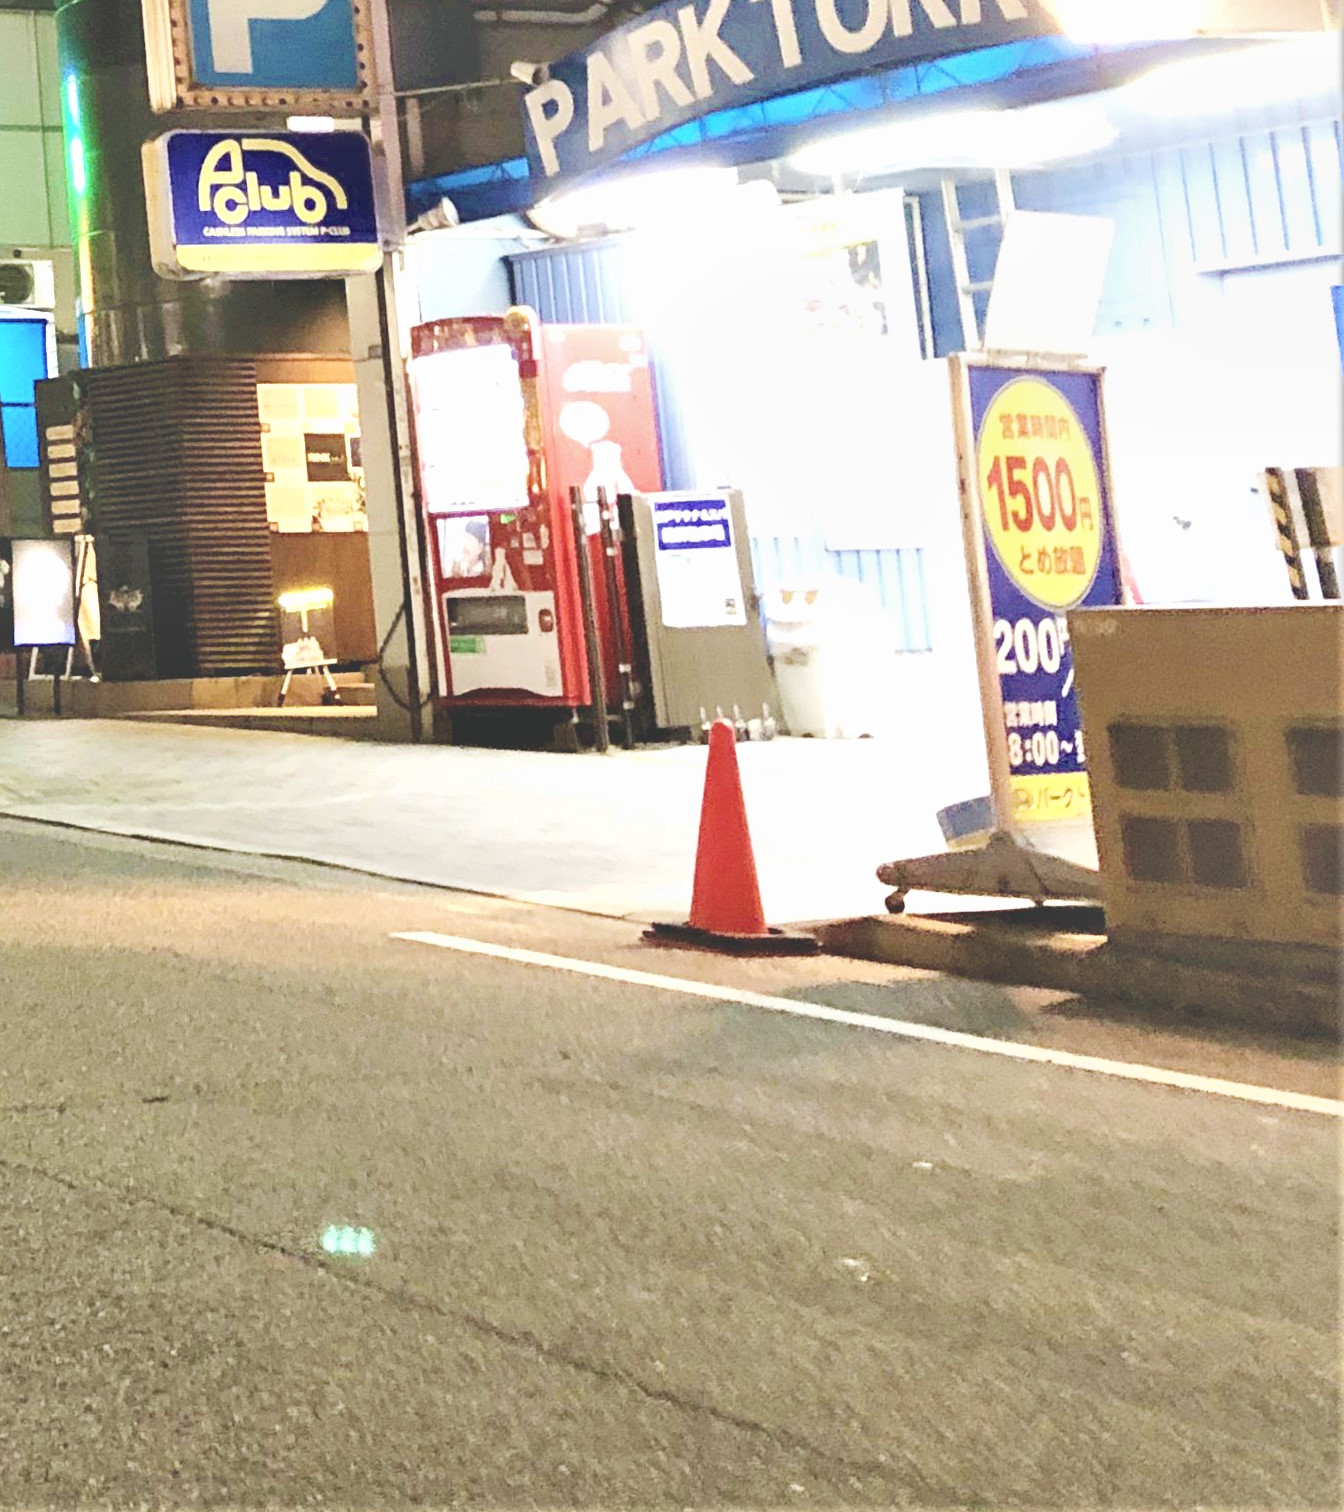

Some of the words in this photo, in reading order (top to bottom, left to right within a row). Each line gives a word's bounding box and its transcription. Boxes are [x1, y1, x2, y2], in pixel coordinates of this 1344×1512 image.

[999, 413, 1071, 441] 営業時間内
[987, 455, 1094, 532] 1500円
[1019, 545, 1086, 575] とめ放題
